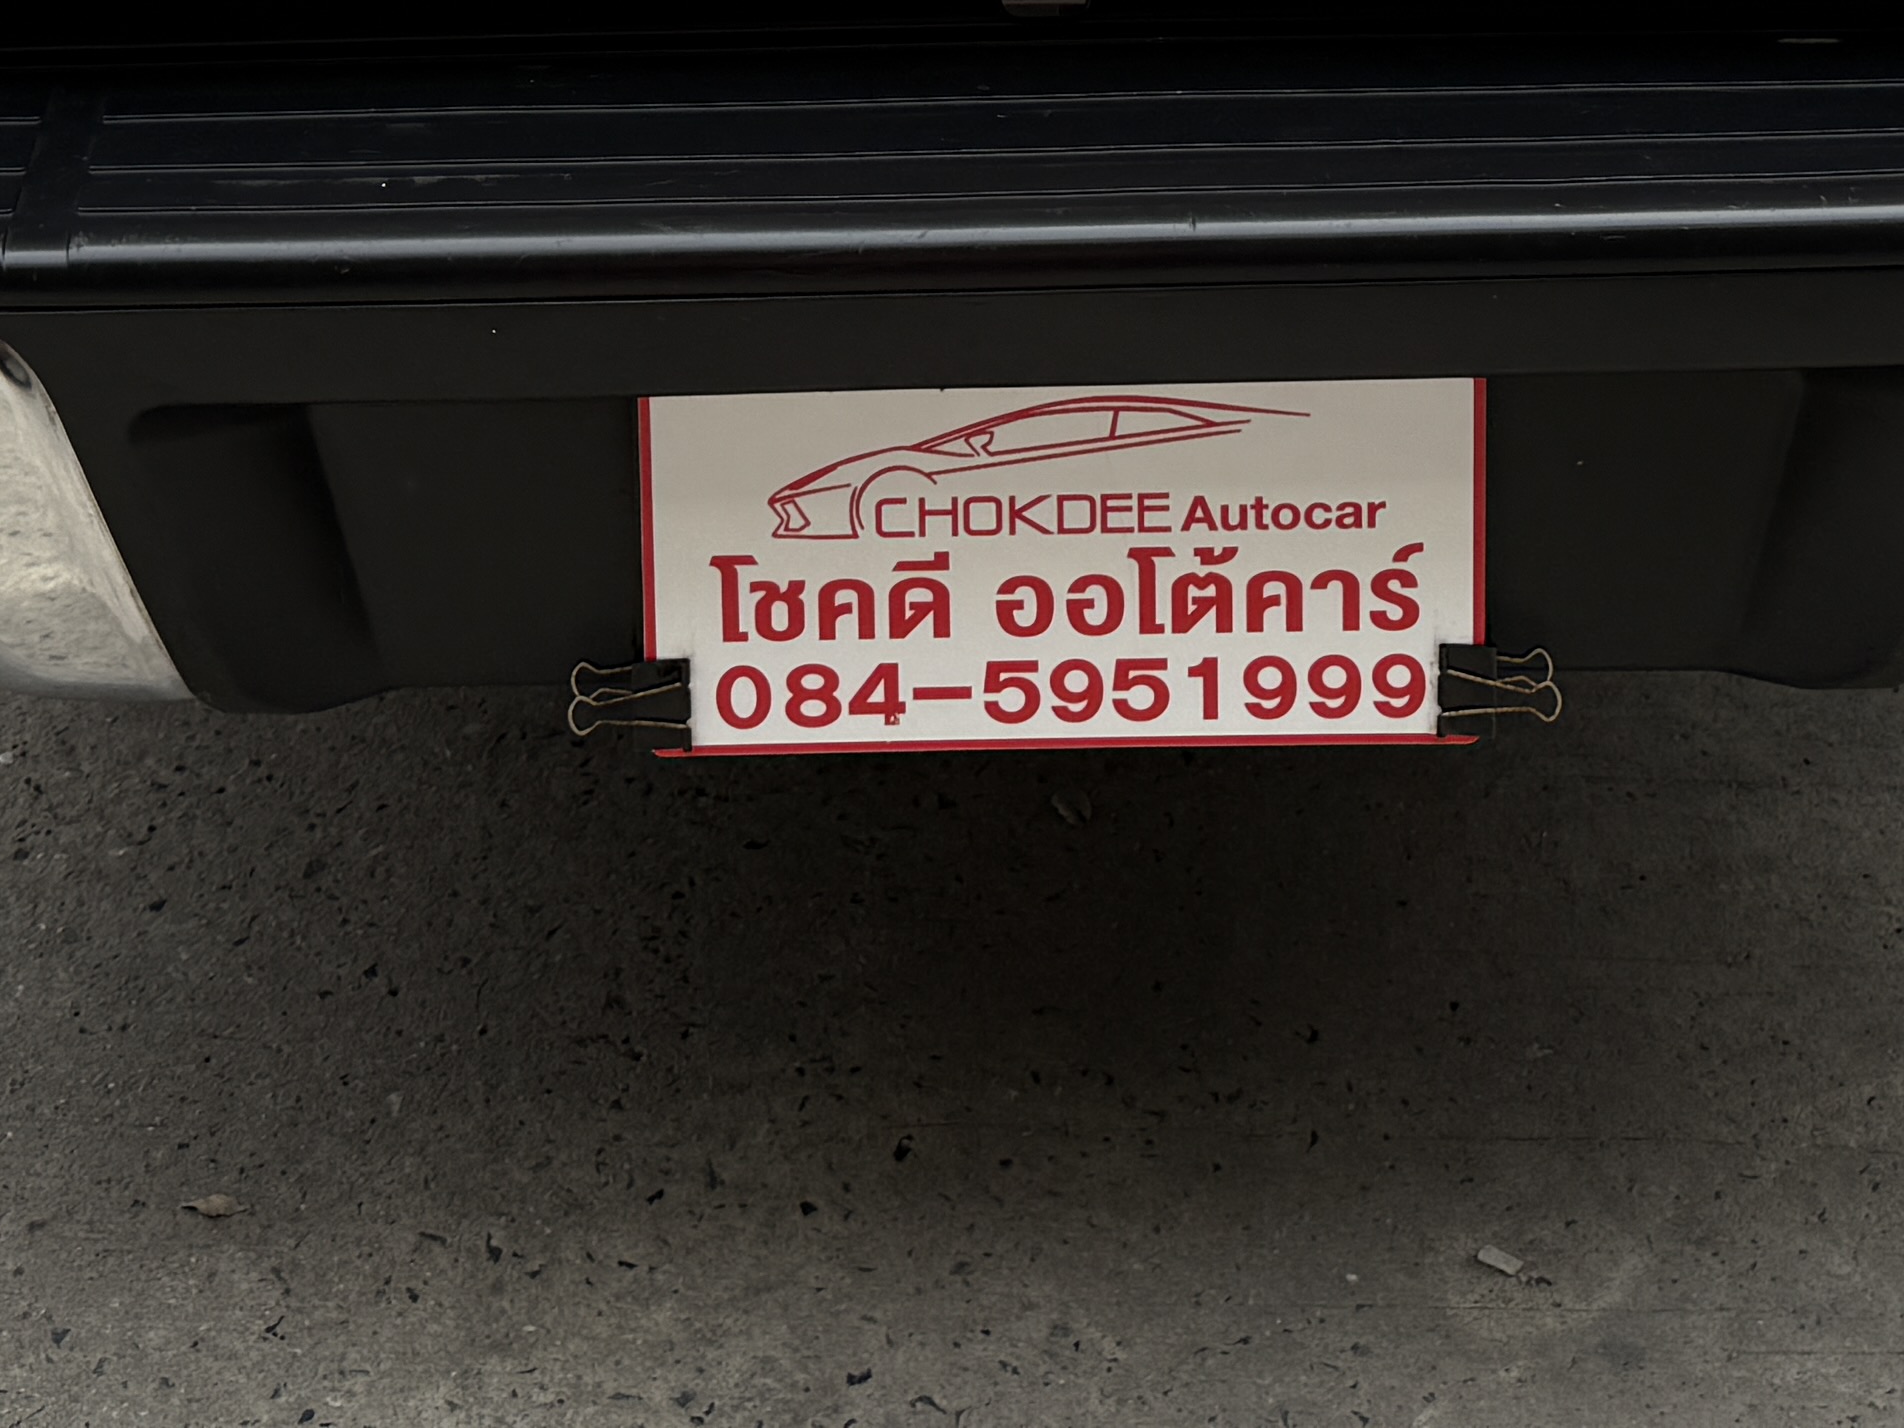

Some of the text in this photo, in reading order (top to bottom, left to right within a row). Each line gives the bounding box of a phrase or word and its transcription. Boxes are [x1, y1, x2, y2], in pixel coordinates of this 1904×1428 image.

[874, 491, 1386, 538] CHOKDEE Autocar
[709, 541, 1425, 643] โชคดี ออโต้คาร์
[715, 655, 1426, 729] 084-5951999
